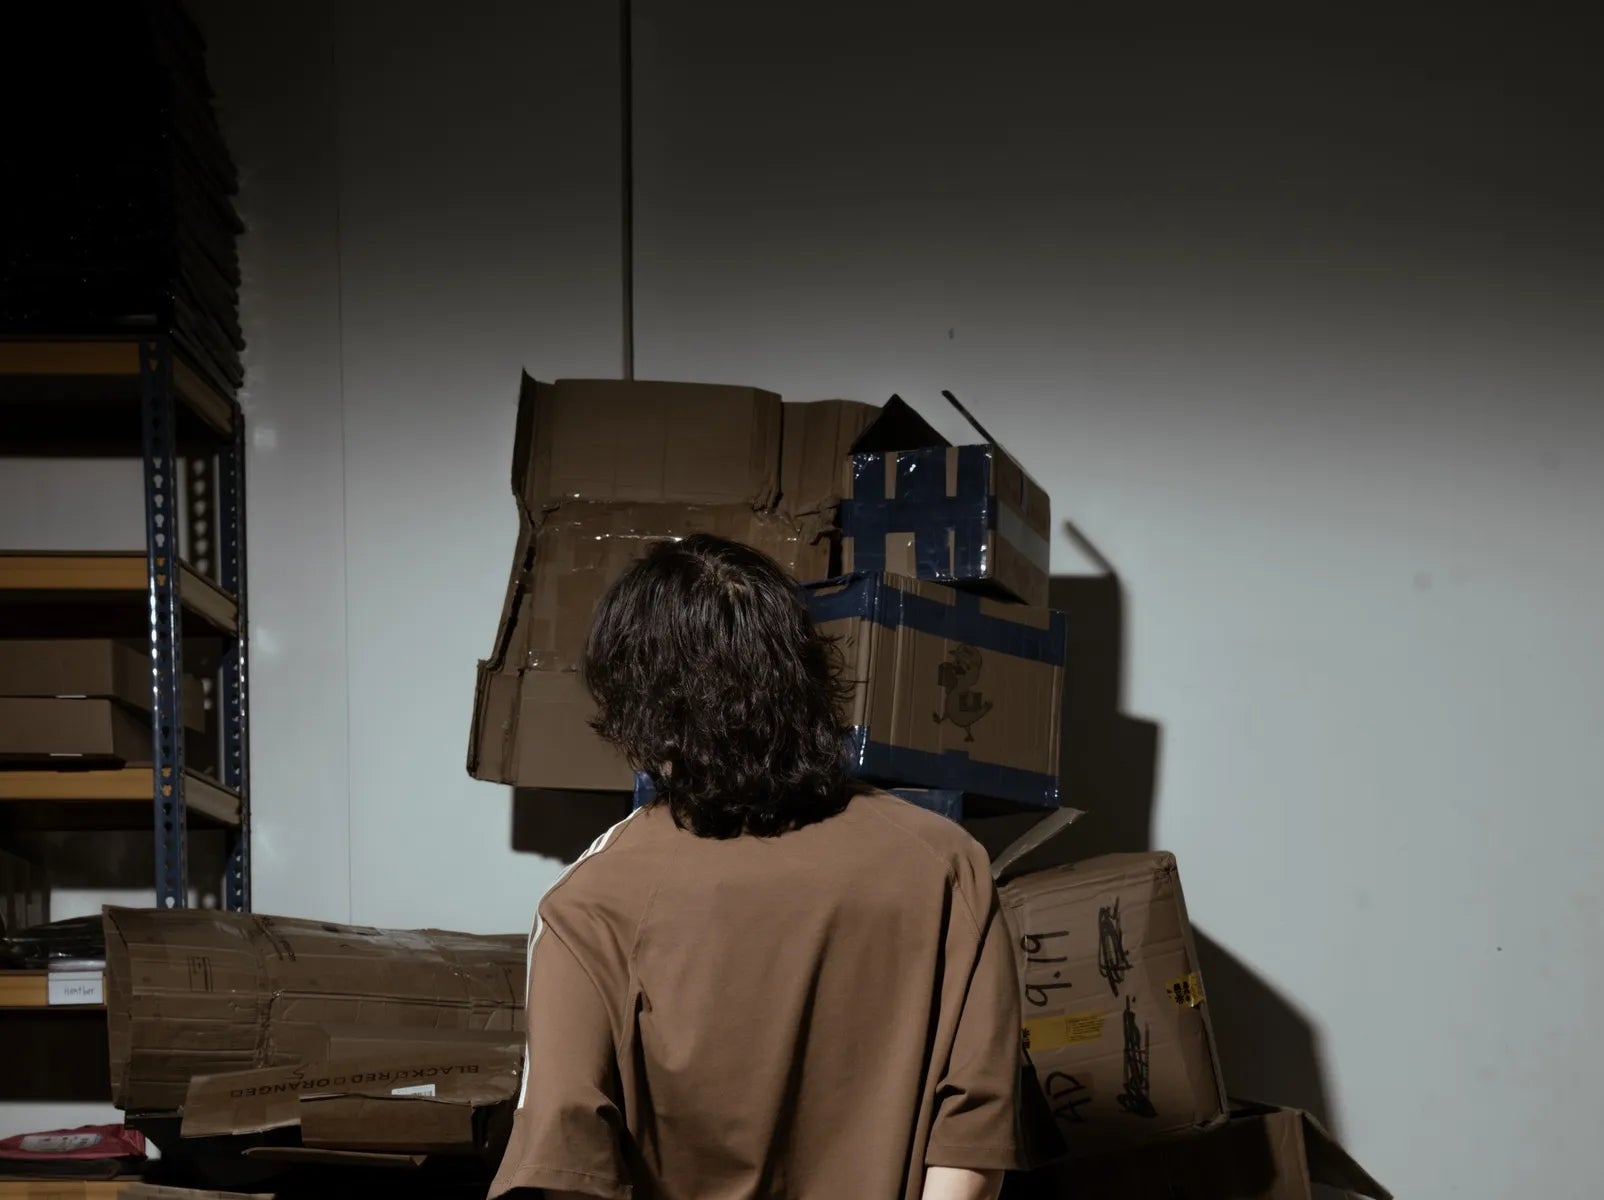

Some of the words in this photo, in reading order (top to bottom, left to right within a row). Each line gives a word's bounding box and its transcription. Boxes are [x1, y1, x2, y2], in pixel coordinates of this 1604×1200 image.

[1020, 929, 1072, 1008] 9.19
[351, 1072, 390, 1084] RED
[413, 1064, 479, 1077] BLACK
[246, 1078, 330, 1096] ORANGE
